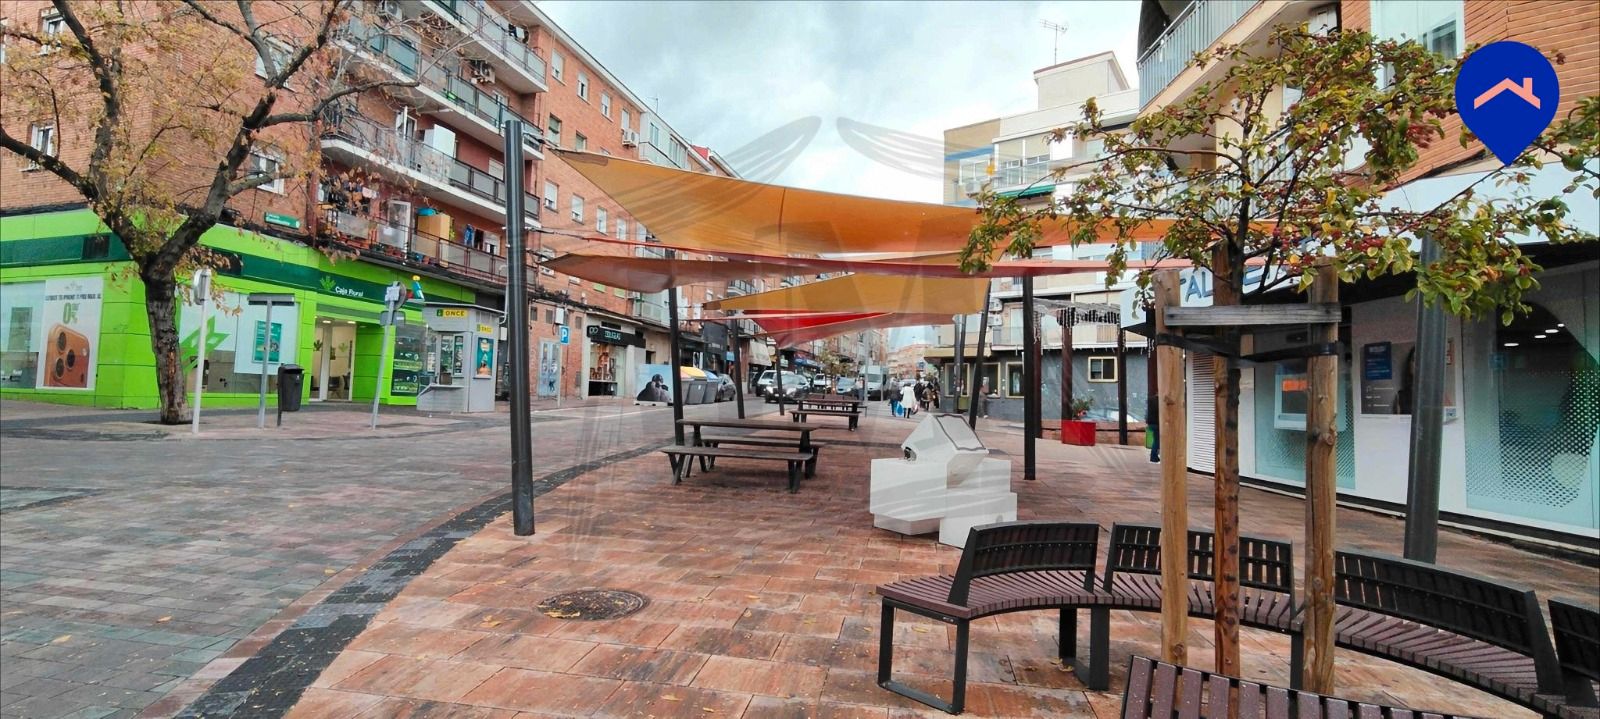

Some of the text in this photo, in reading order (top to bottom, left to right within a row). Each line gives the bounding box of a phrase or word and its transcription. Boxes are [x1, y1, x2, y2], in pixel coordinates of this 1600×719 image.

[335, 286, 364, 297] Caja Rural
[561, 328, 568, 342] P
